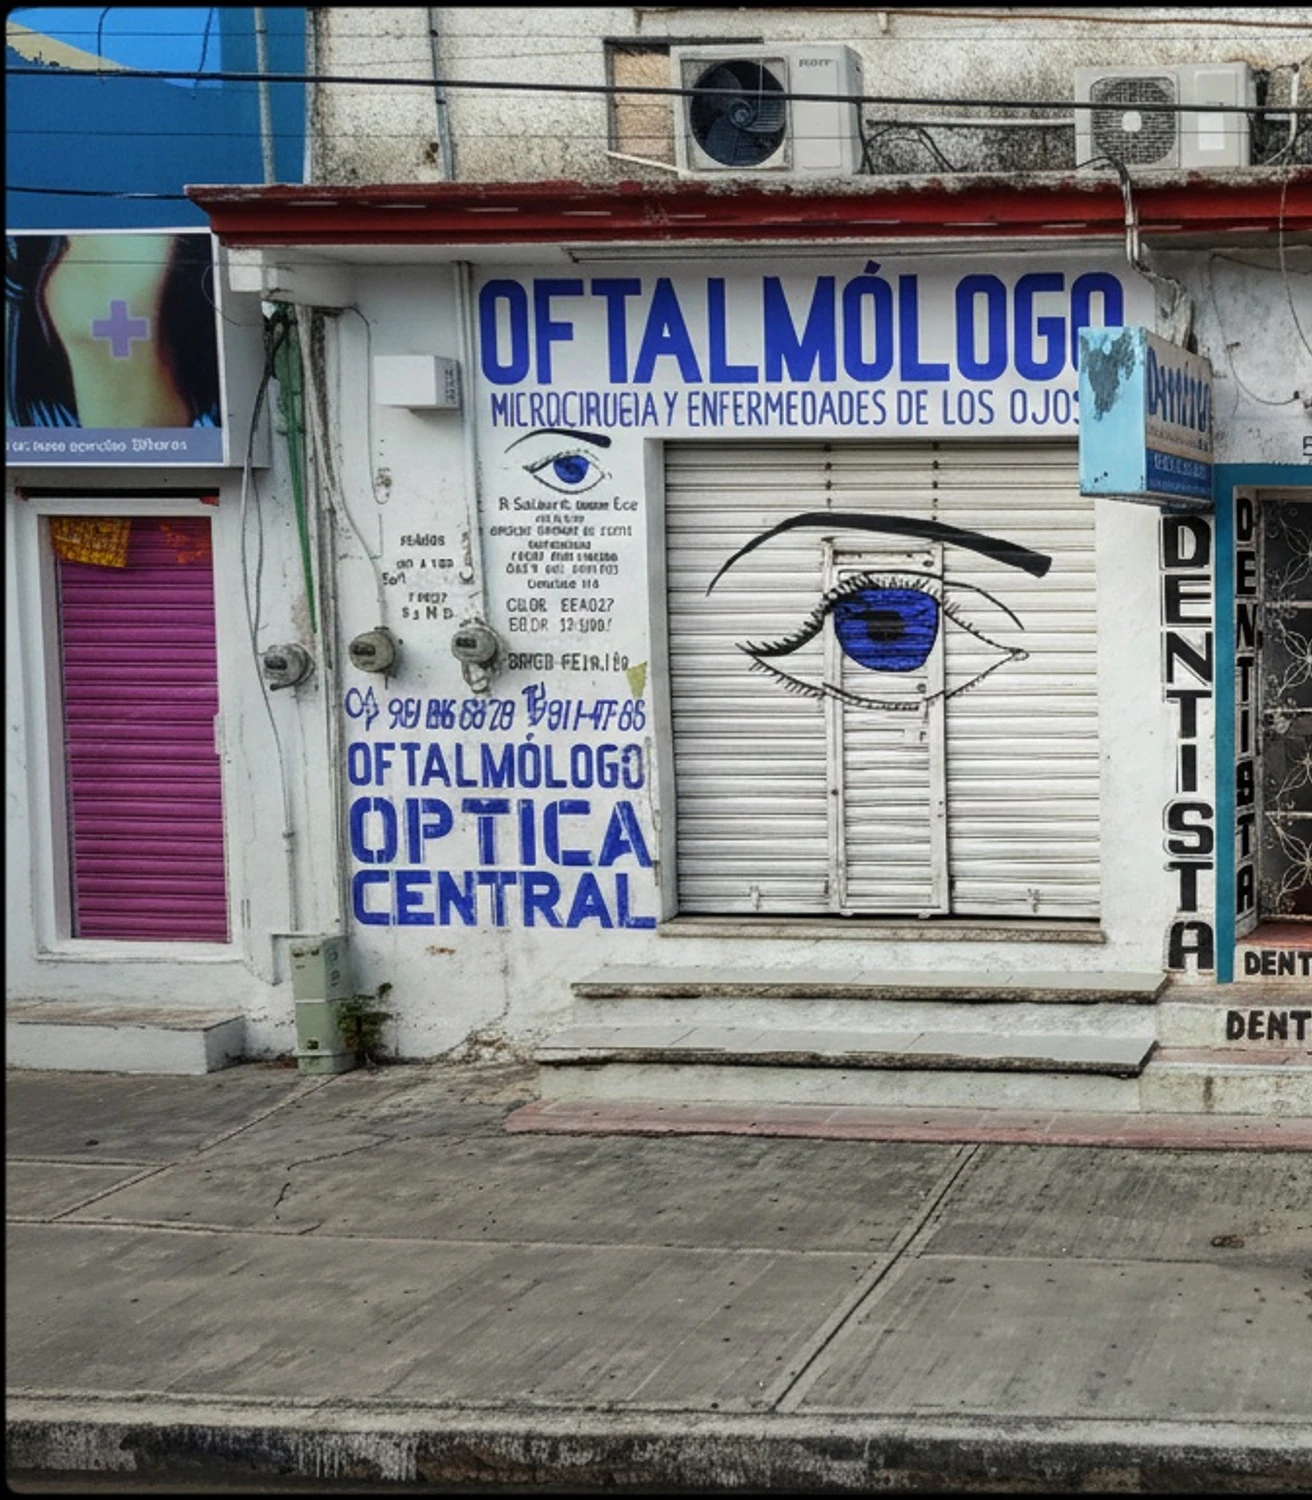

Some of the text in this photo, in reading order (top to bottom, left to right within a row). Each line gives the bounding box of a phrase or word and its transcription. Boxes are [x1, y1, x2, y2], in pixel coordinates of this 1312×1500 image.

[478, 260, 1124, 385] OFTALMÓLOGO
[687, 389, 887, 427] ENFERMEDADES
[896, 389, 929, 425] DE
[942, 389, 995, 425] LOS
[1009, 388, 1080, 425] OJO
[1236, 497, 1257, 914] DENTISTA
[348, 732, 646, 790] OFTALMÓLOGO
[1160, 514, 1214, 969] DENTISTA
[350, 796, 652, 867] OPTICA
[352, 869, 658, 929] CENTRAL
